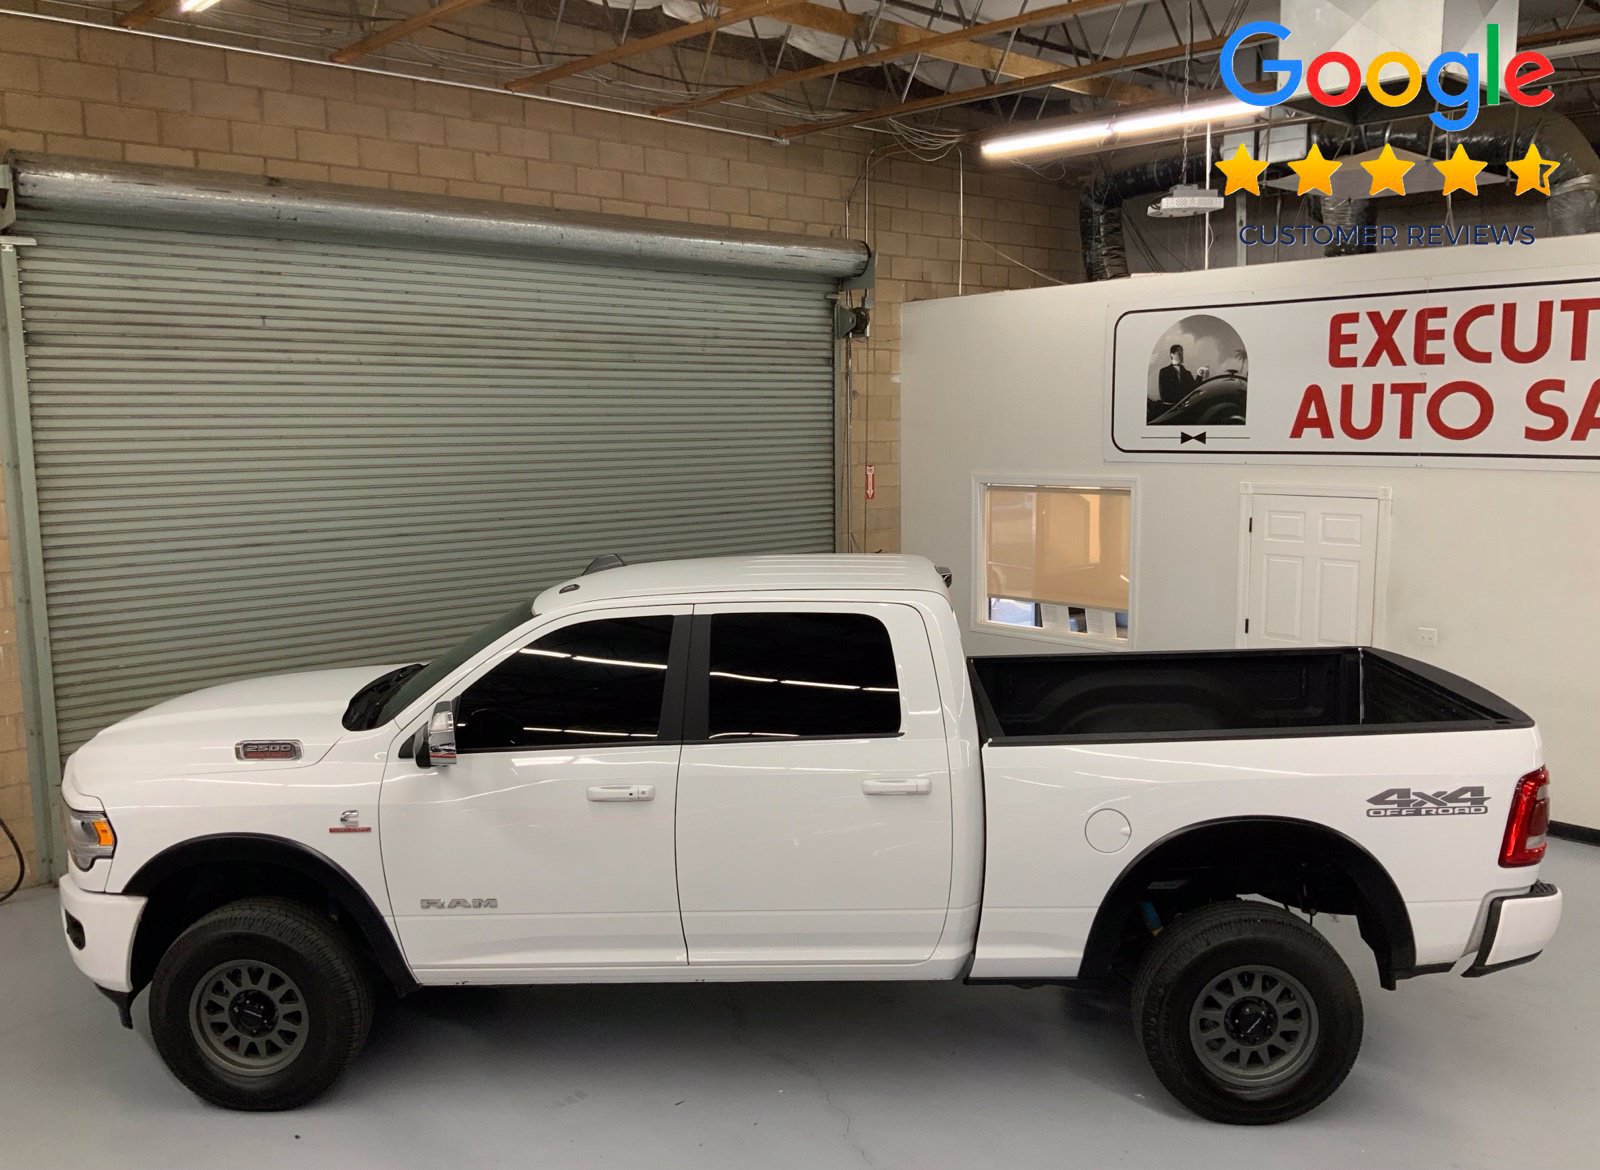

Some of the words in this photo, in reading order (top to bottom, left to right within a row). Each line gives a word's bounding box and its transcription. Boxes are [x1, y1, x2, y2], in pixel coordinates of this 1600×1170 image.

[1328, 298, 1600, 368] EXECUT
[1289, 380, 1495, 440] AUTO
[246, 744, 291, 752] 2500
[1368, 808, 1416, 817] OFF
[1421, 806, 1487, 815] ROAD
[420, 898, 498, 909] RAM
